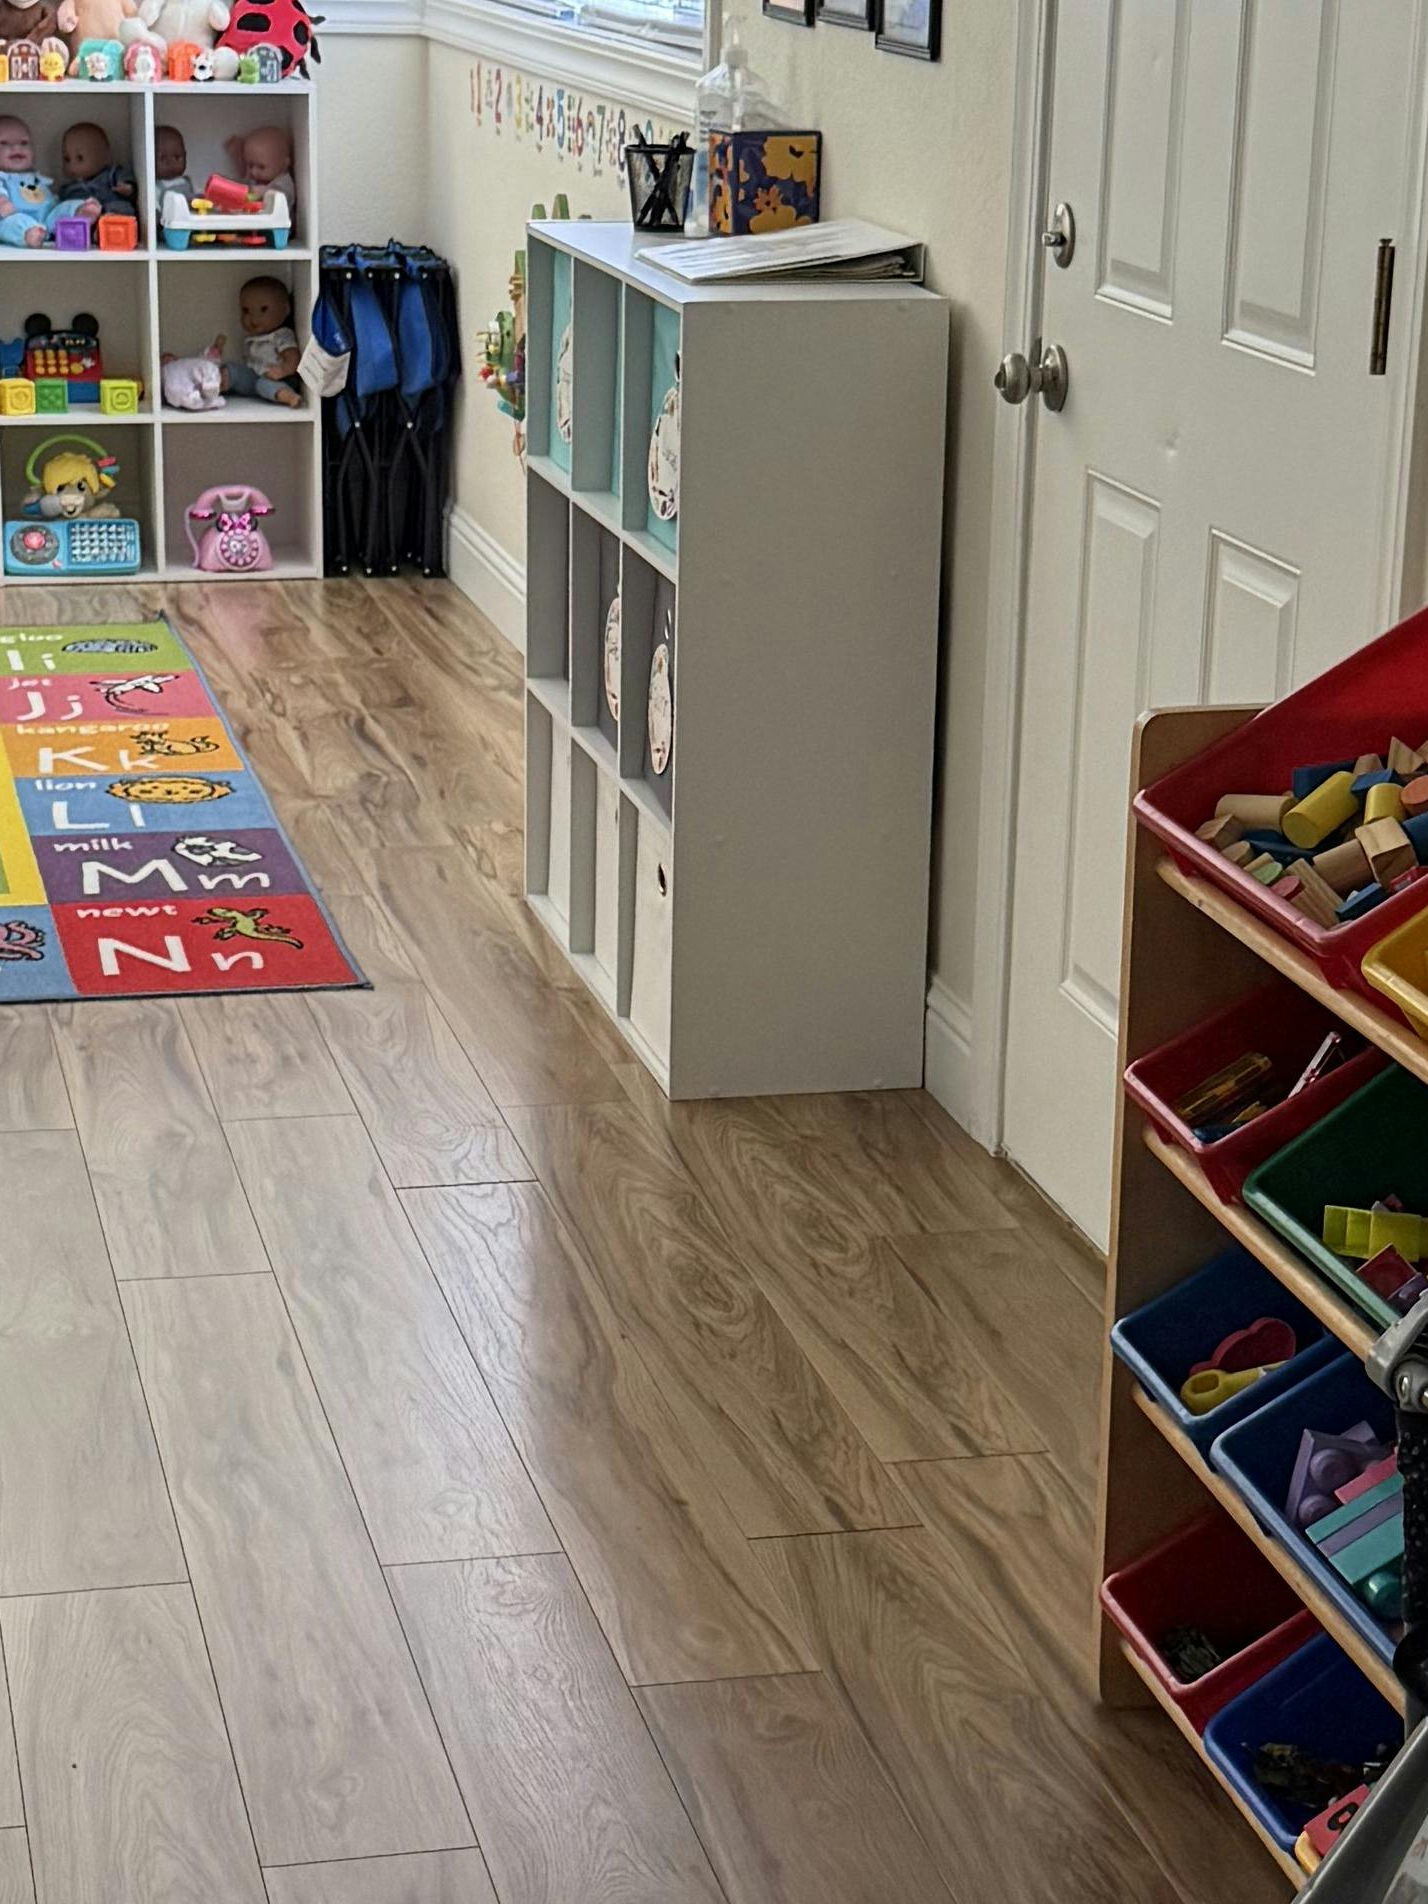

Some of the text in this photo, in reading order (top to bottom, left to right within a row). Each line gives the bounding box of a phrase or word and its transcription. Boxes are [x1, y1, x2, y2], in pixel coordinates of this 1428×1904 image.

[596, 104, 606, 164] 7
[9, 677, 53, 691] jet
[16, 691, 83, 721] J j
[16, 722, 171, 736] kangaroo
[38, 747, 162, 774] K k
[35, 778, 97, 792] lion
[52, 801, 110, 830] L
[53, 837, 134, 852] milk
[82, 859, 271, 895] M m
[76, 903, 178, 918] newt
[98, 935, 265, 976] N n
